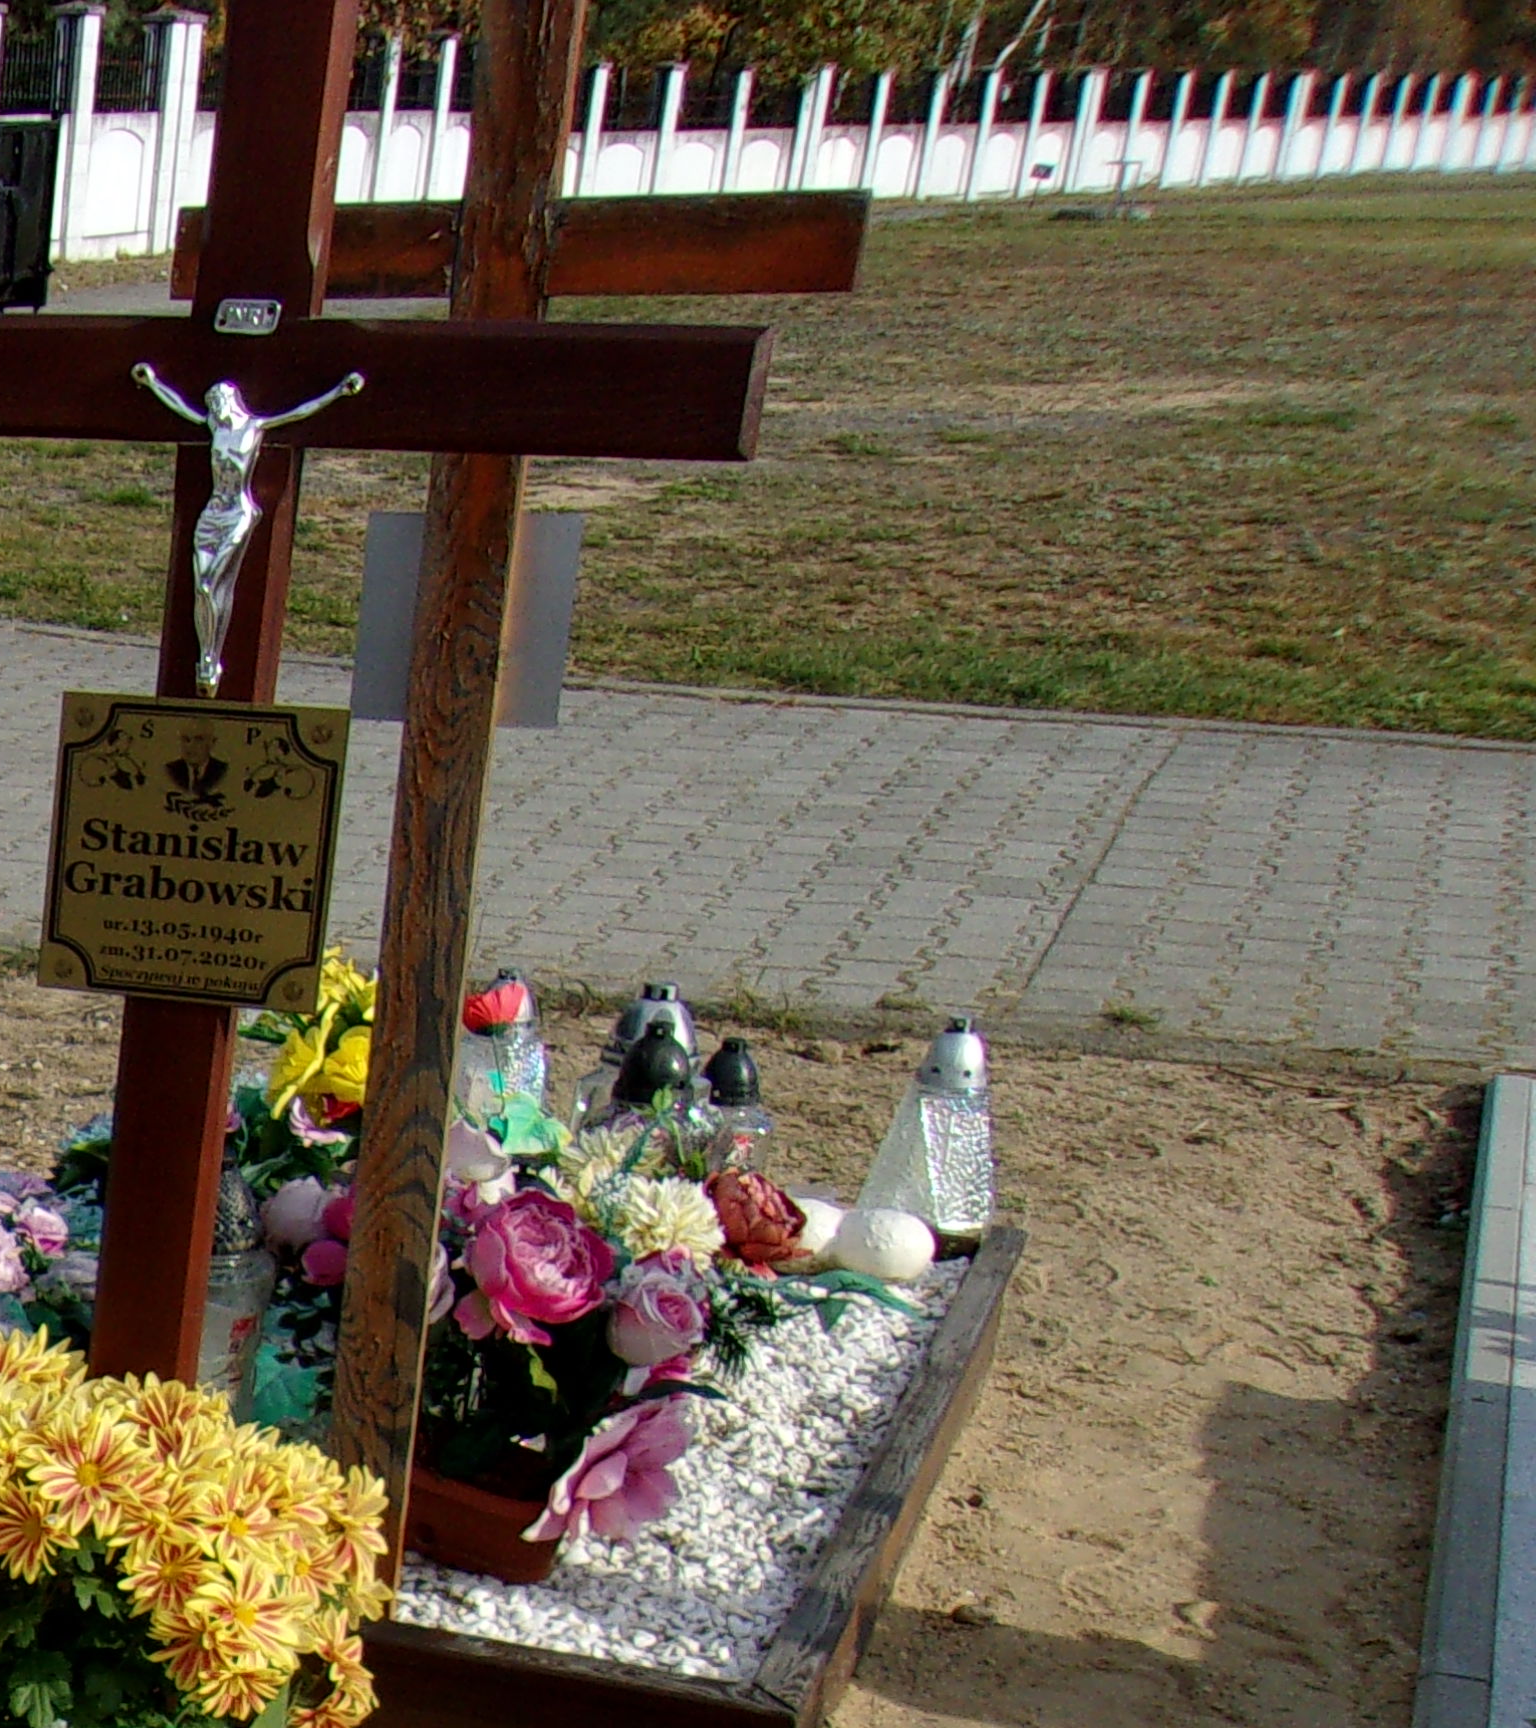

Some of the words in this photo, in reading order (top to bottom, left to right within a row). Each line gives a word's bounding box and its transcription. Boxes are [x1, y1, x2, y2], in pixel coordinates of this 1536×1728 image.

[139, 719, 155, 739] Ś
[245, 726, 262, 746] P
[81, 817, 309, 868] Stanisław
[64, 860, 315, 914] Grabowski
